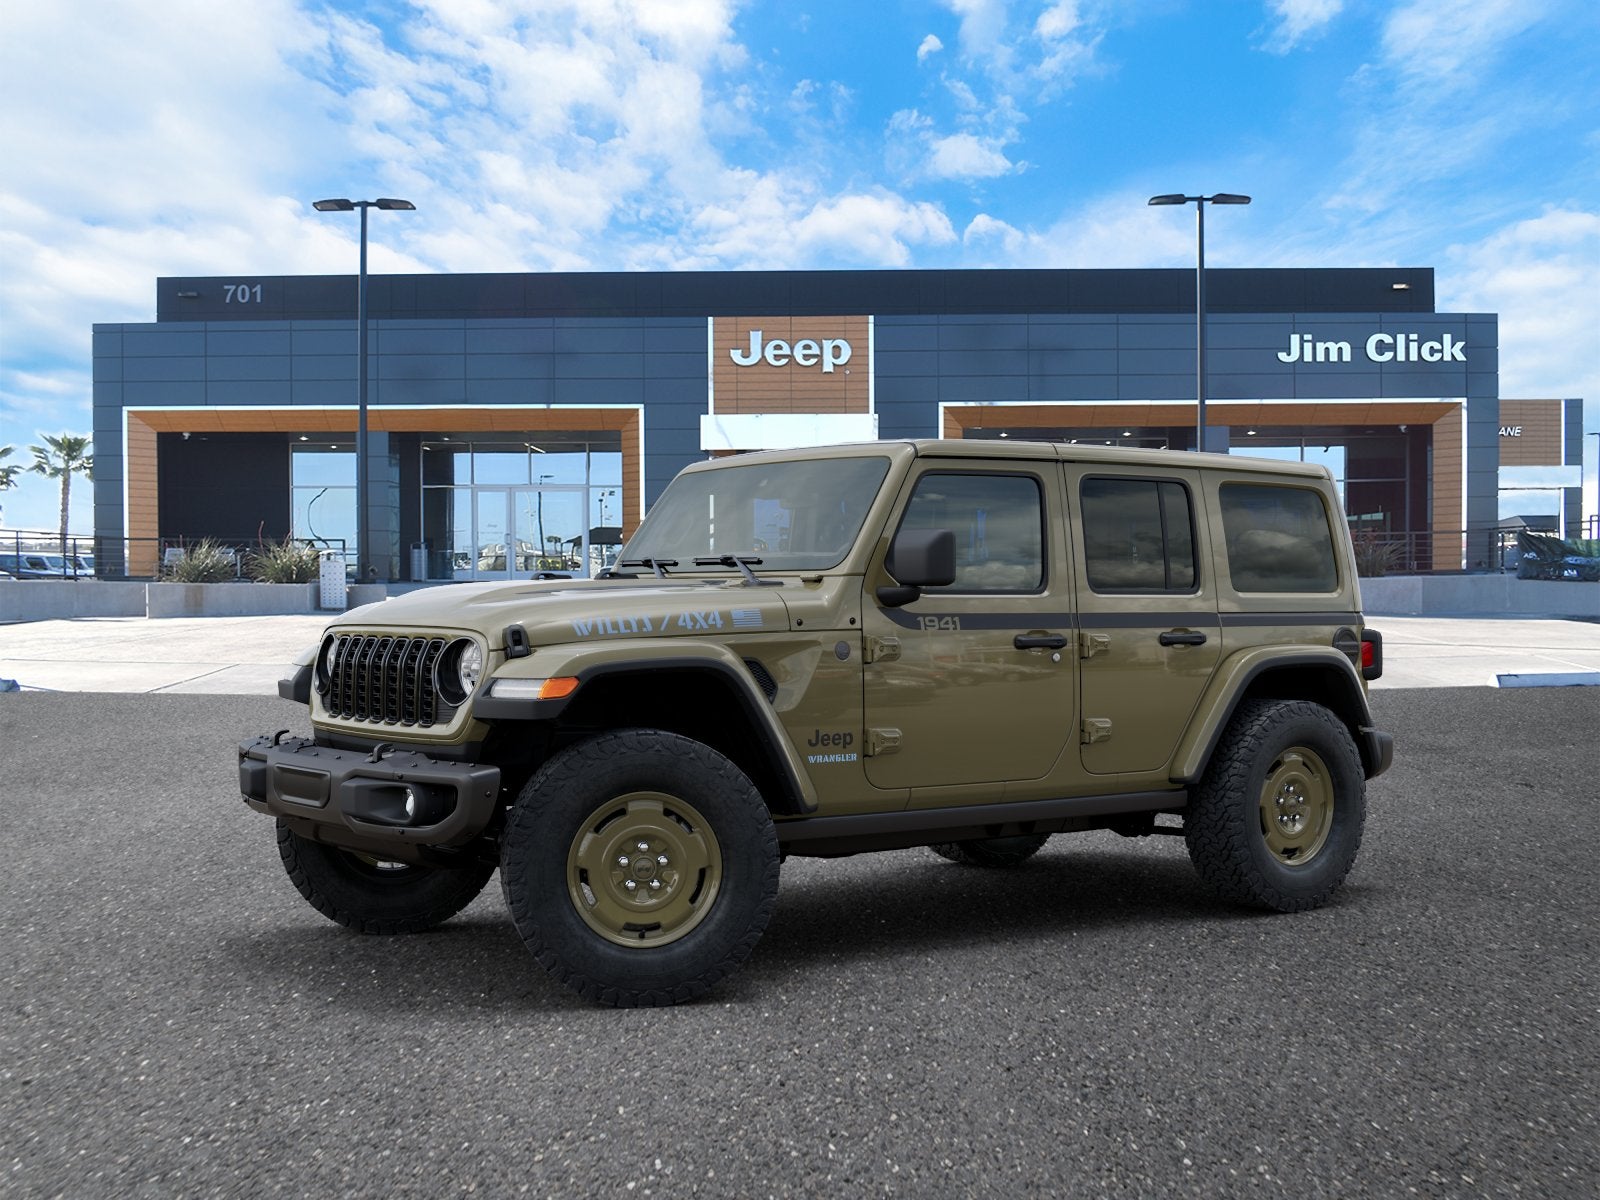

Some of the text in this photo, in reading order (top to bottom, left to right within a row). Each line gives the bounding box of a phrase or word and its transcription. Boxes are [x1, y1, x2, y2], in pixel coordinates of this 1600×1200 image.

[223, 284, 261, 303] 701
[729, 330, 852, 373] Jeep
[1277, 333, 1467, 362] Jim Click
[569, 613, 654, 637] WILLYS
[677, 609, 724, 631] 4X4
[916, 616, 960, 631] 1941
[808, 729, 853, 748] Jeep
[808, 753, 857, 764] WRANGLER
